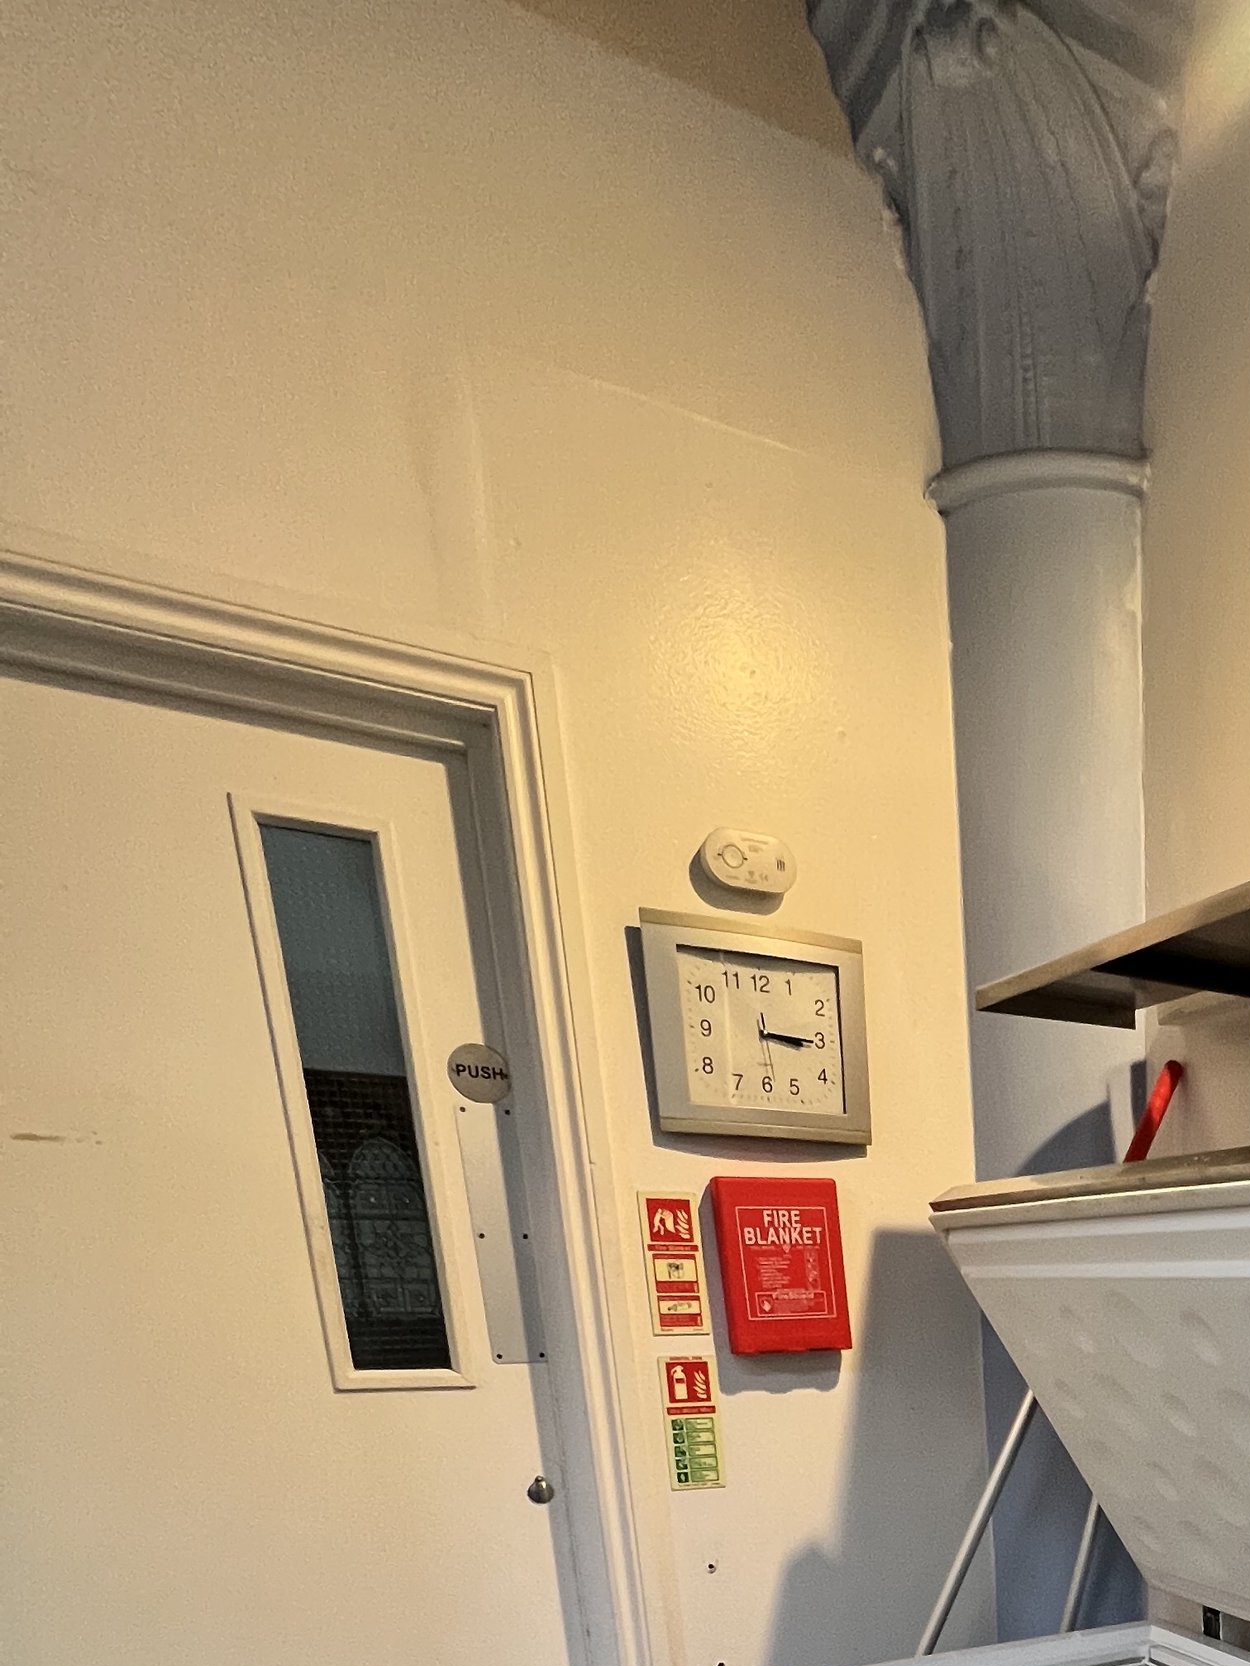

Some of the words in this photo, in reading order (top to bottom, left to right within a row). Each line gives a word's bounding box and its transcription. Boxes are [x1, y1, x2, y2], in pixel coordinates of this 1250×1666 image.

[722, 971, 740, 989] 11
[750, 975, 770, 993] 12
[785, 979, 792, 996] 1
[695, 984, 716, 1003] 10
[814, 999, 826, 1017] 2
[700, 1019, 712, 1037] 9
[814, 1032, 826, 1049] 3
[455, 1063, 504, 1080] PUSH
[702, 1056, 714, 1074] 8
[817, 1068, 828, 1084] 4
[732, 1074, 744, 1091] 7
[762, 1076, 773, 1093] 6
[789, 1078, 800, 1096] 5
[763, 1209, 802, 1228] FIRE
[744, 1226, 823, 1245] BLANKET
